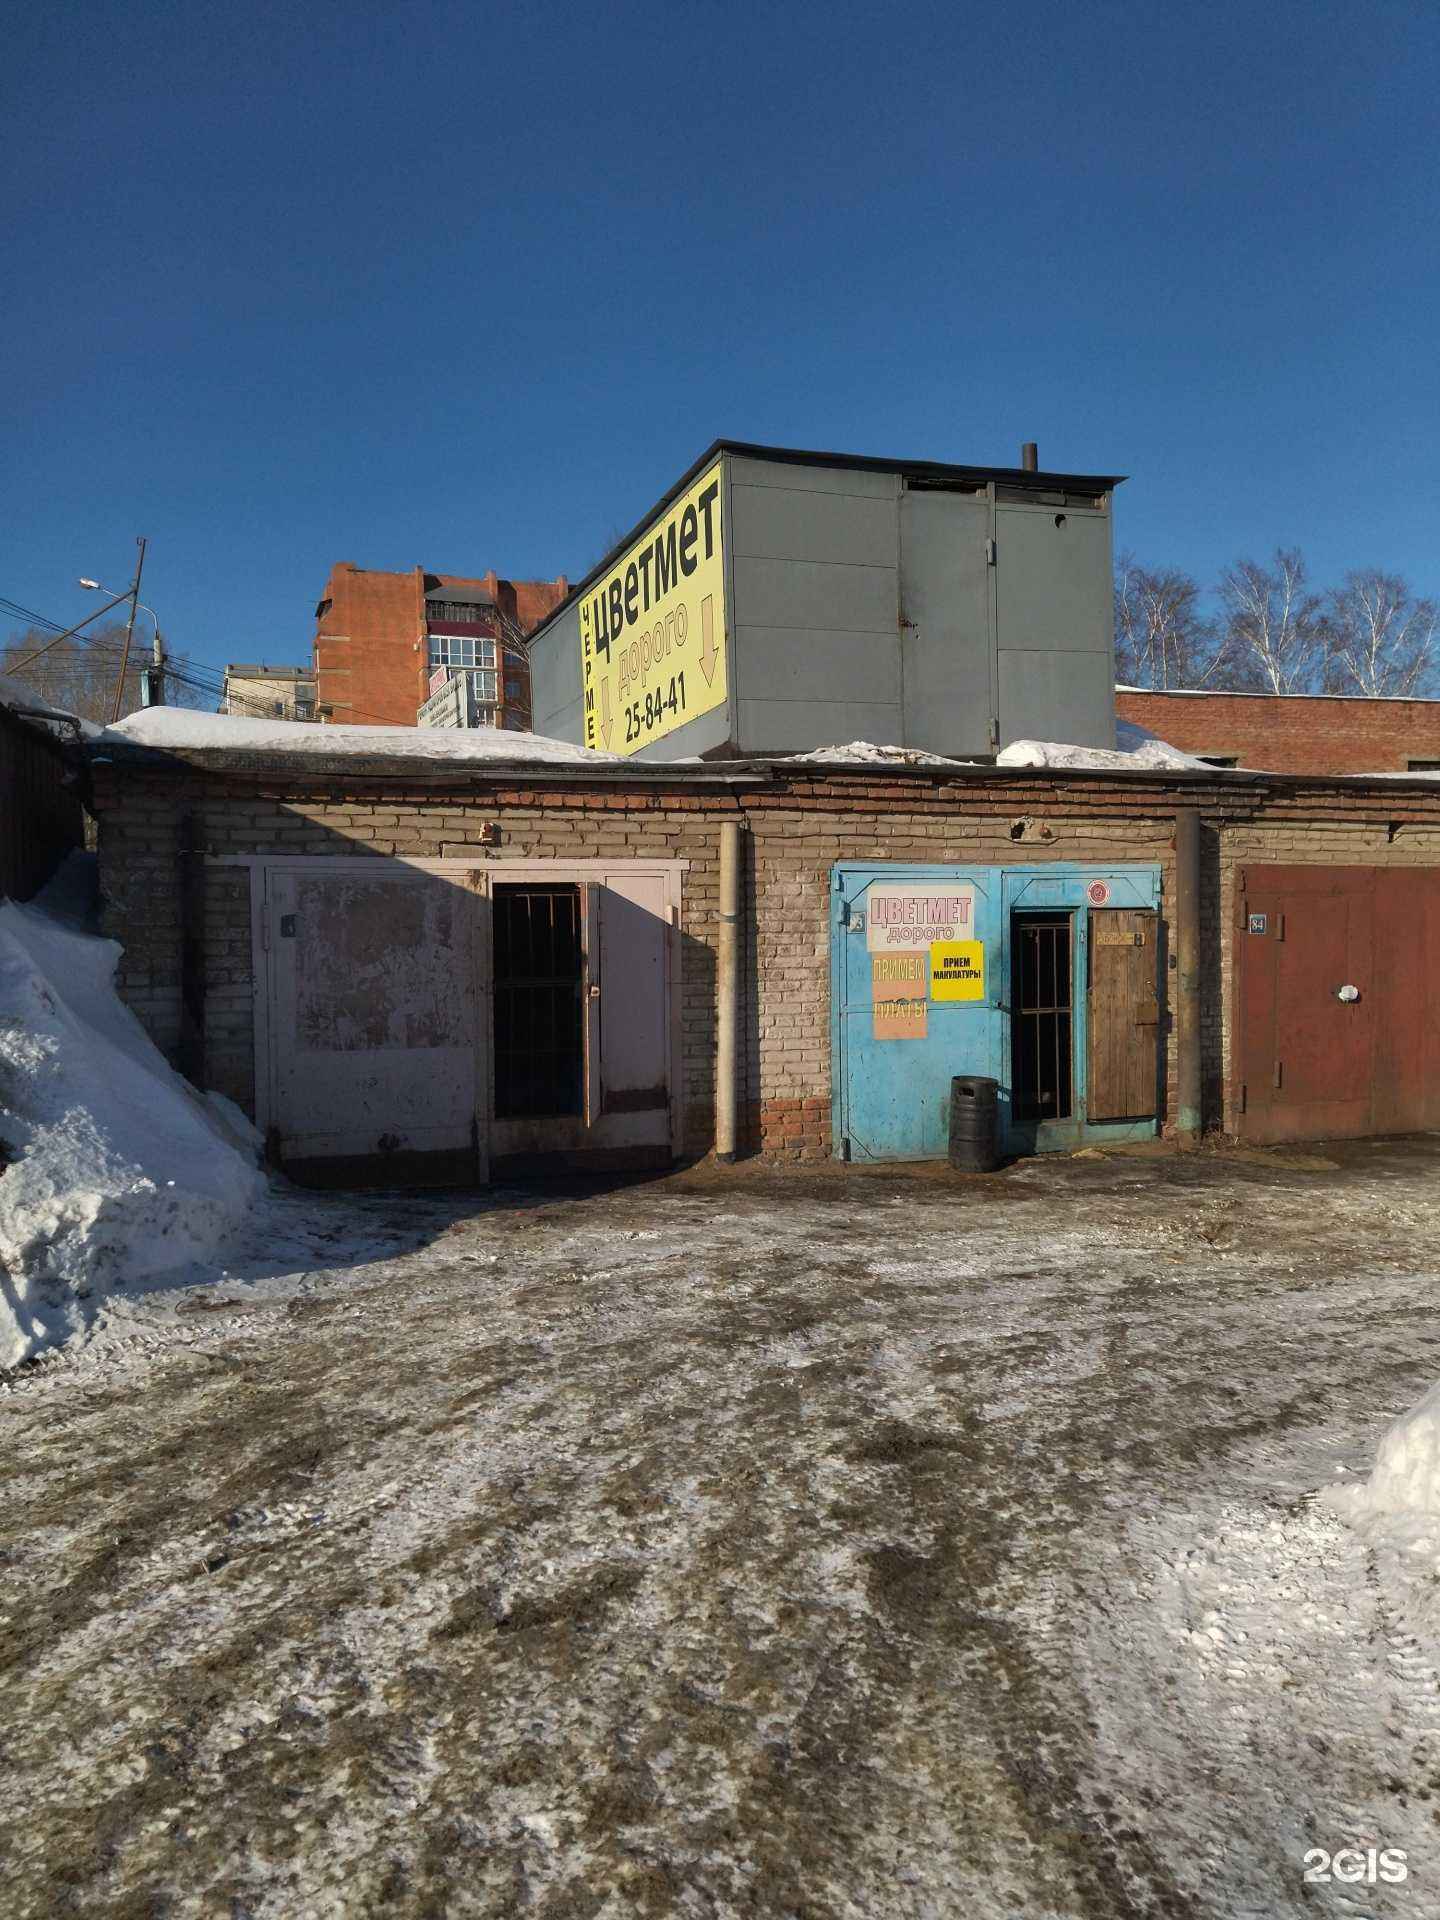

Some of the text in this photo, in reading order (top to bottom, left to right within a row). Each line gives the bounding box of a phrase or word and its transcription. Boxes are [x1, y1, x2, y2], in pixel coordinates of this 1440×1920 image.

[618, 602, 689, 701] дорого
[582, 603, 596, 750] ЧЕРМЕ
[624, 670, 687, 743] 25-84-41
[870, 897, 972, 928] ЦВЕТМЕТ
[887, 926, 955, 944] дорого
[933, 970, 981, 980] МАКУЛАТУРЫ
[943, 957, 971, 968] ПРИЕМ
